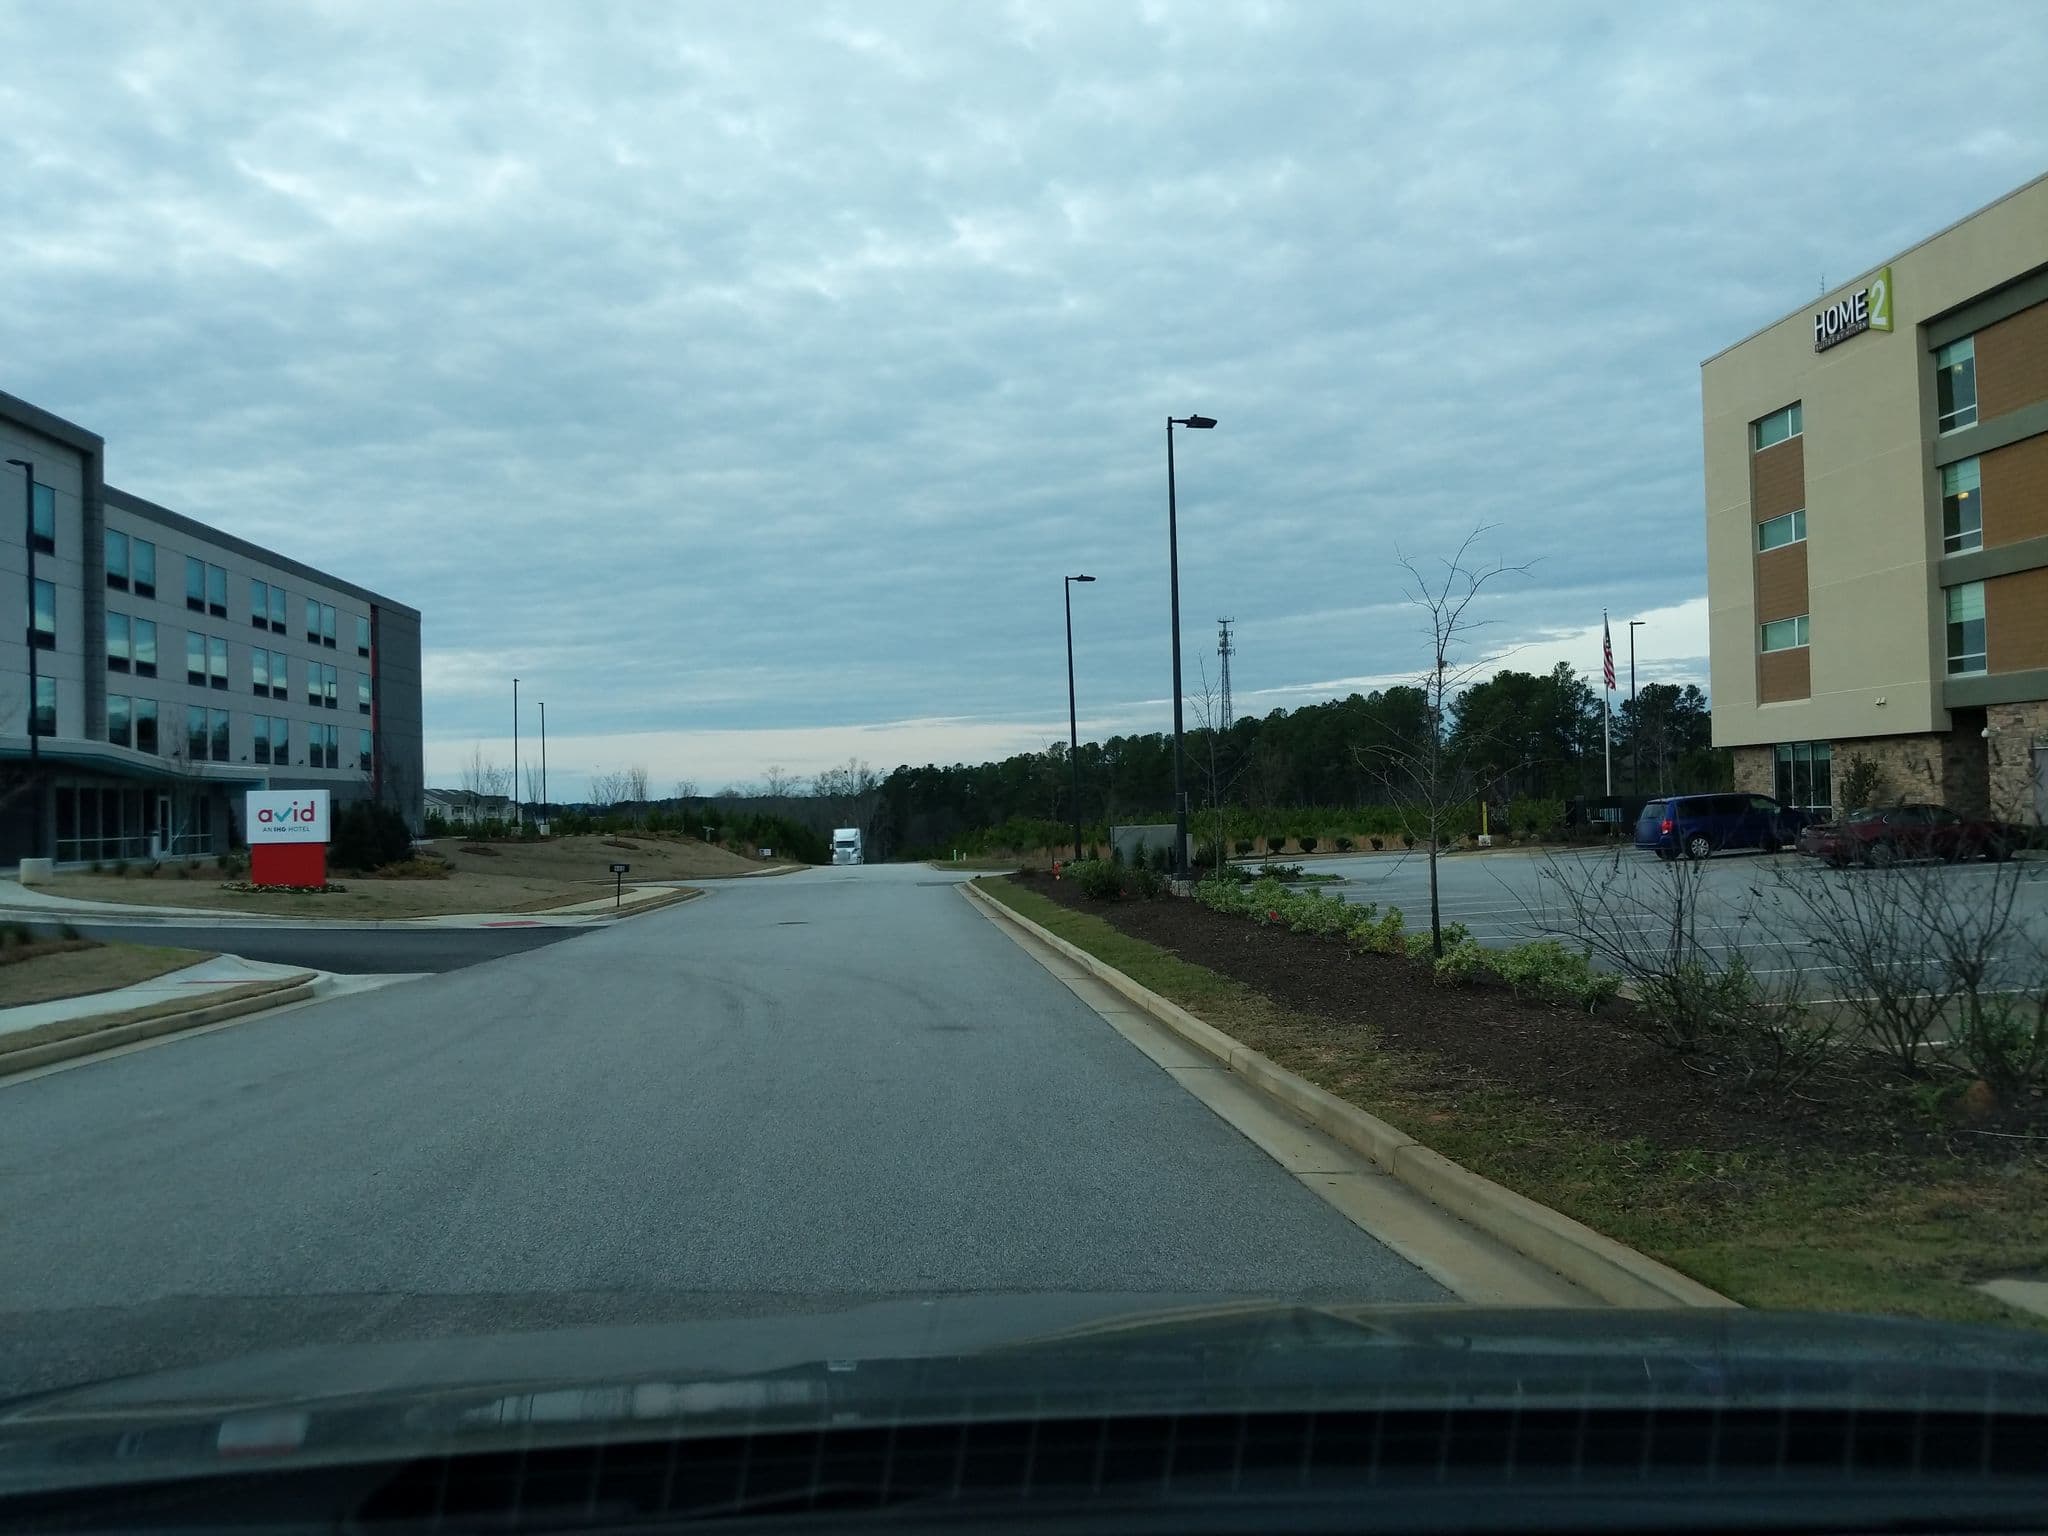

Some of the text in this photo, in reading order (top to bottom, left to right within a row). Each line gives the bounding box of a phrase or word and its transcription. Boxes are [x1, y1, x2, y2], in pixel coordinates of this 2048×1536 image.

[1814, 289, 1868, 342] HOME
[1871, 279, 1887, 326] 2
[257, 801, 315, 823] avid
